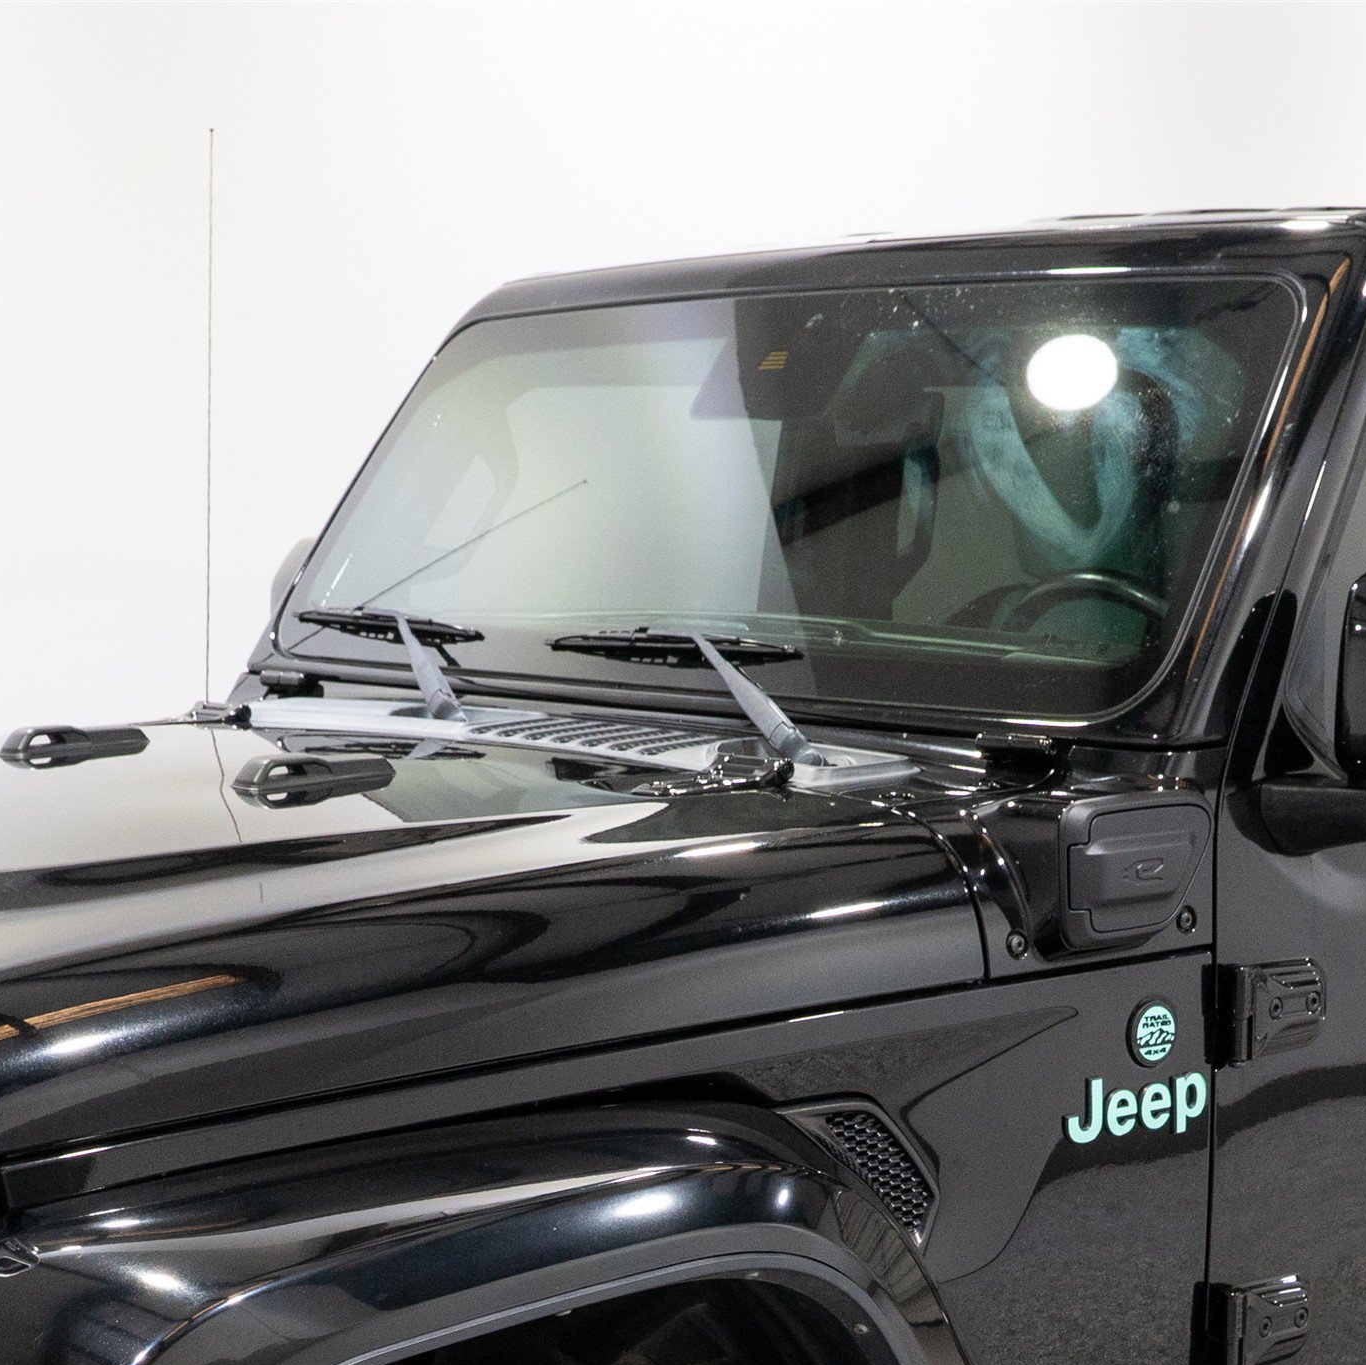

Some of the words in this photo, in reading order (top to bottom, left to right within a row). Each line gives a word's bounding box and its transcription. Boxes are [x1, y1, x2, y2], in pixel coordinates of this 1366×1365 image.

[1144, 1014, 1170, 1022] TRAIL
[1142, 1020, 1172, 1029] RATED
[1065, 1072, 1207, 1144] Jeep
